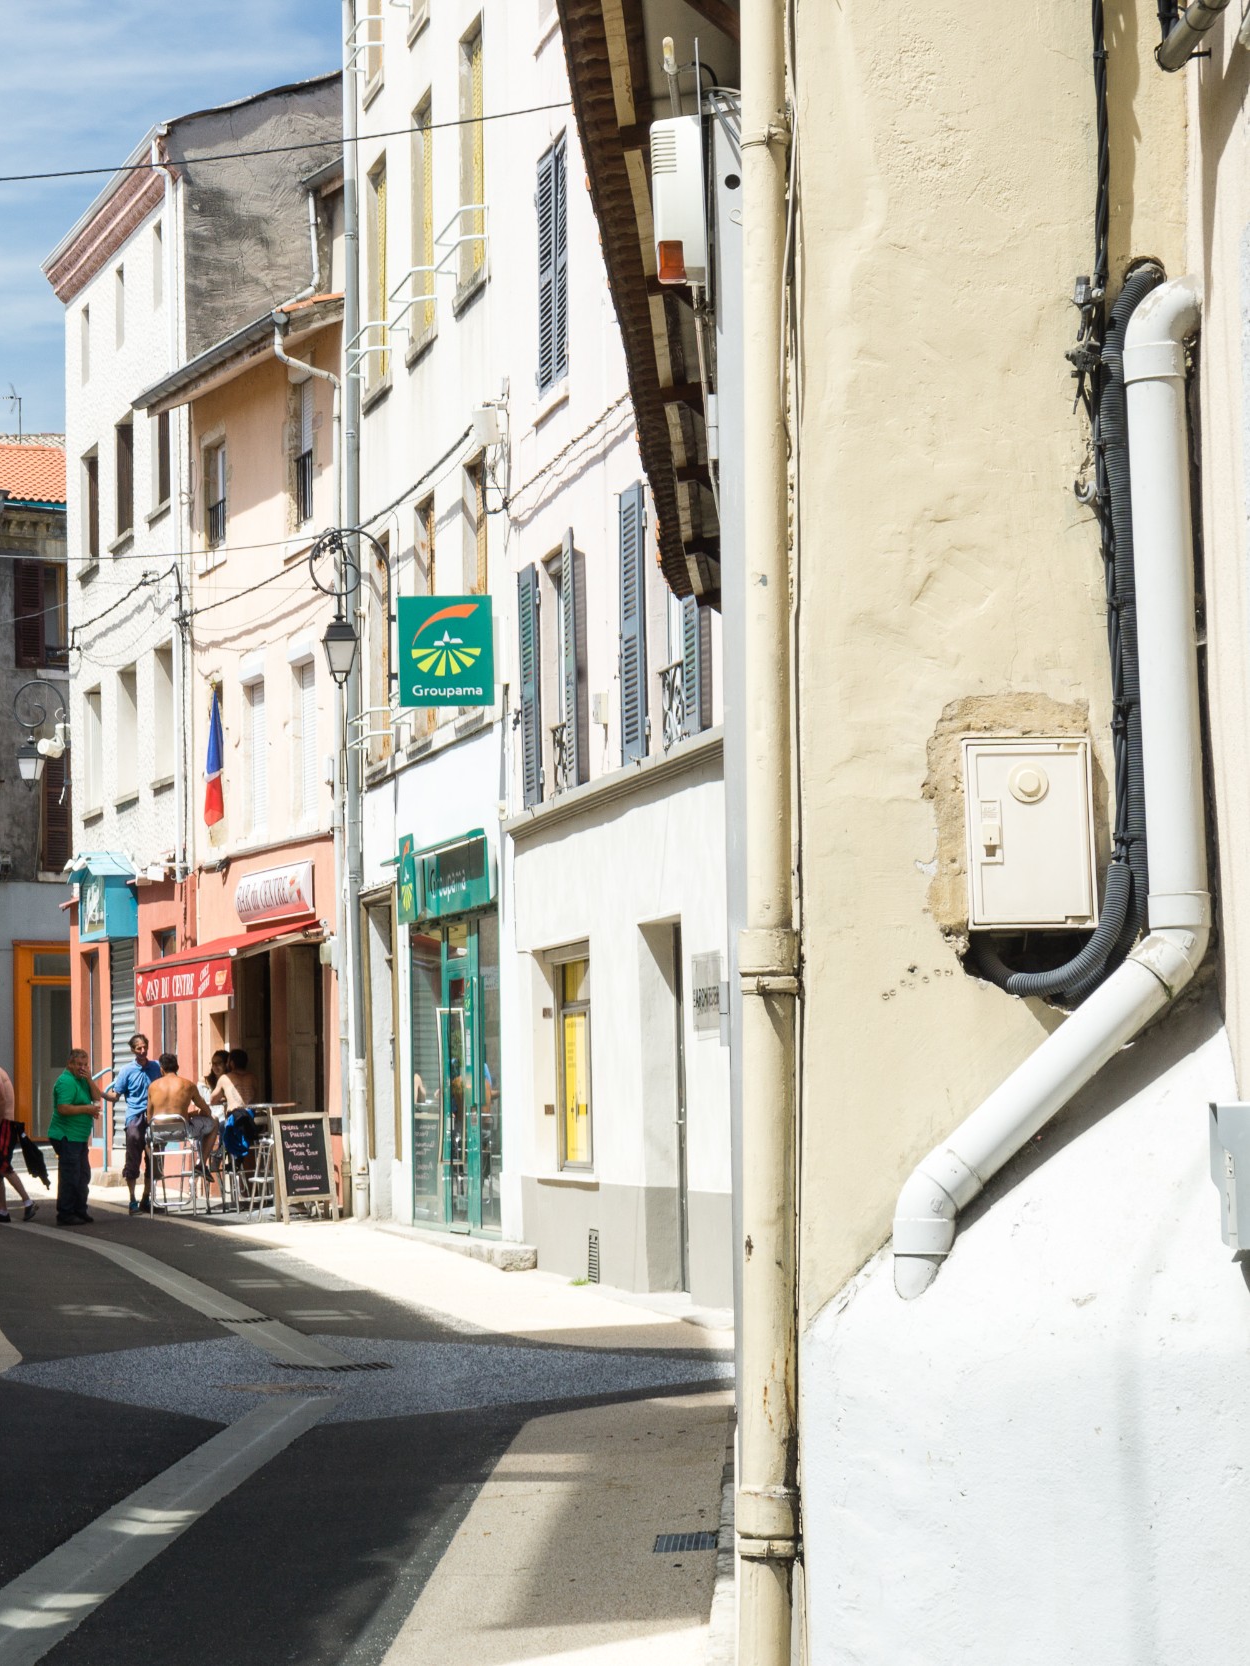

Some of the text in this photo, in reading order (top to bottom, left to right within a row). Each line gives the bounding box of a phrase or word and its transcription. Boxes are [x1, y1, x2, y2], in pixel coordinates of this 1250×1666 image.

[412, 685, 483, 698] Groupama
[237, 884, 252, 913] BAR
[259, 875, 290, 908] CENTRE
[172, 973, 195, 997] CENTRE
